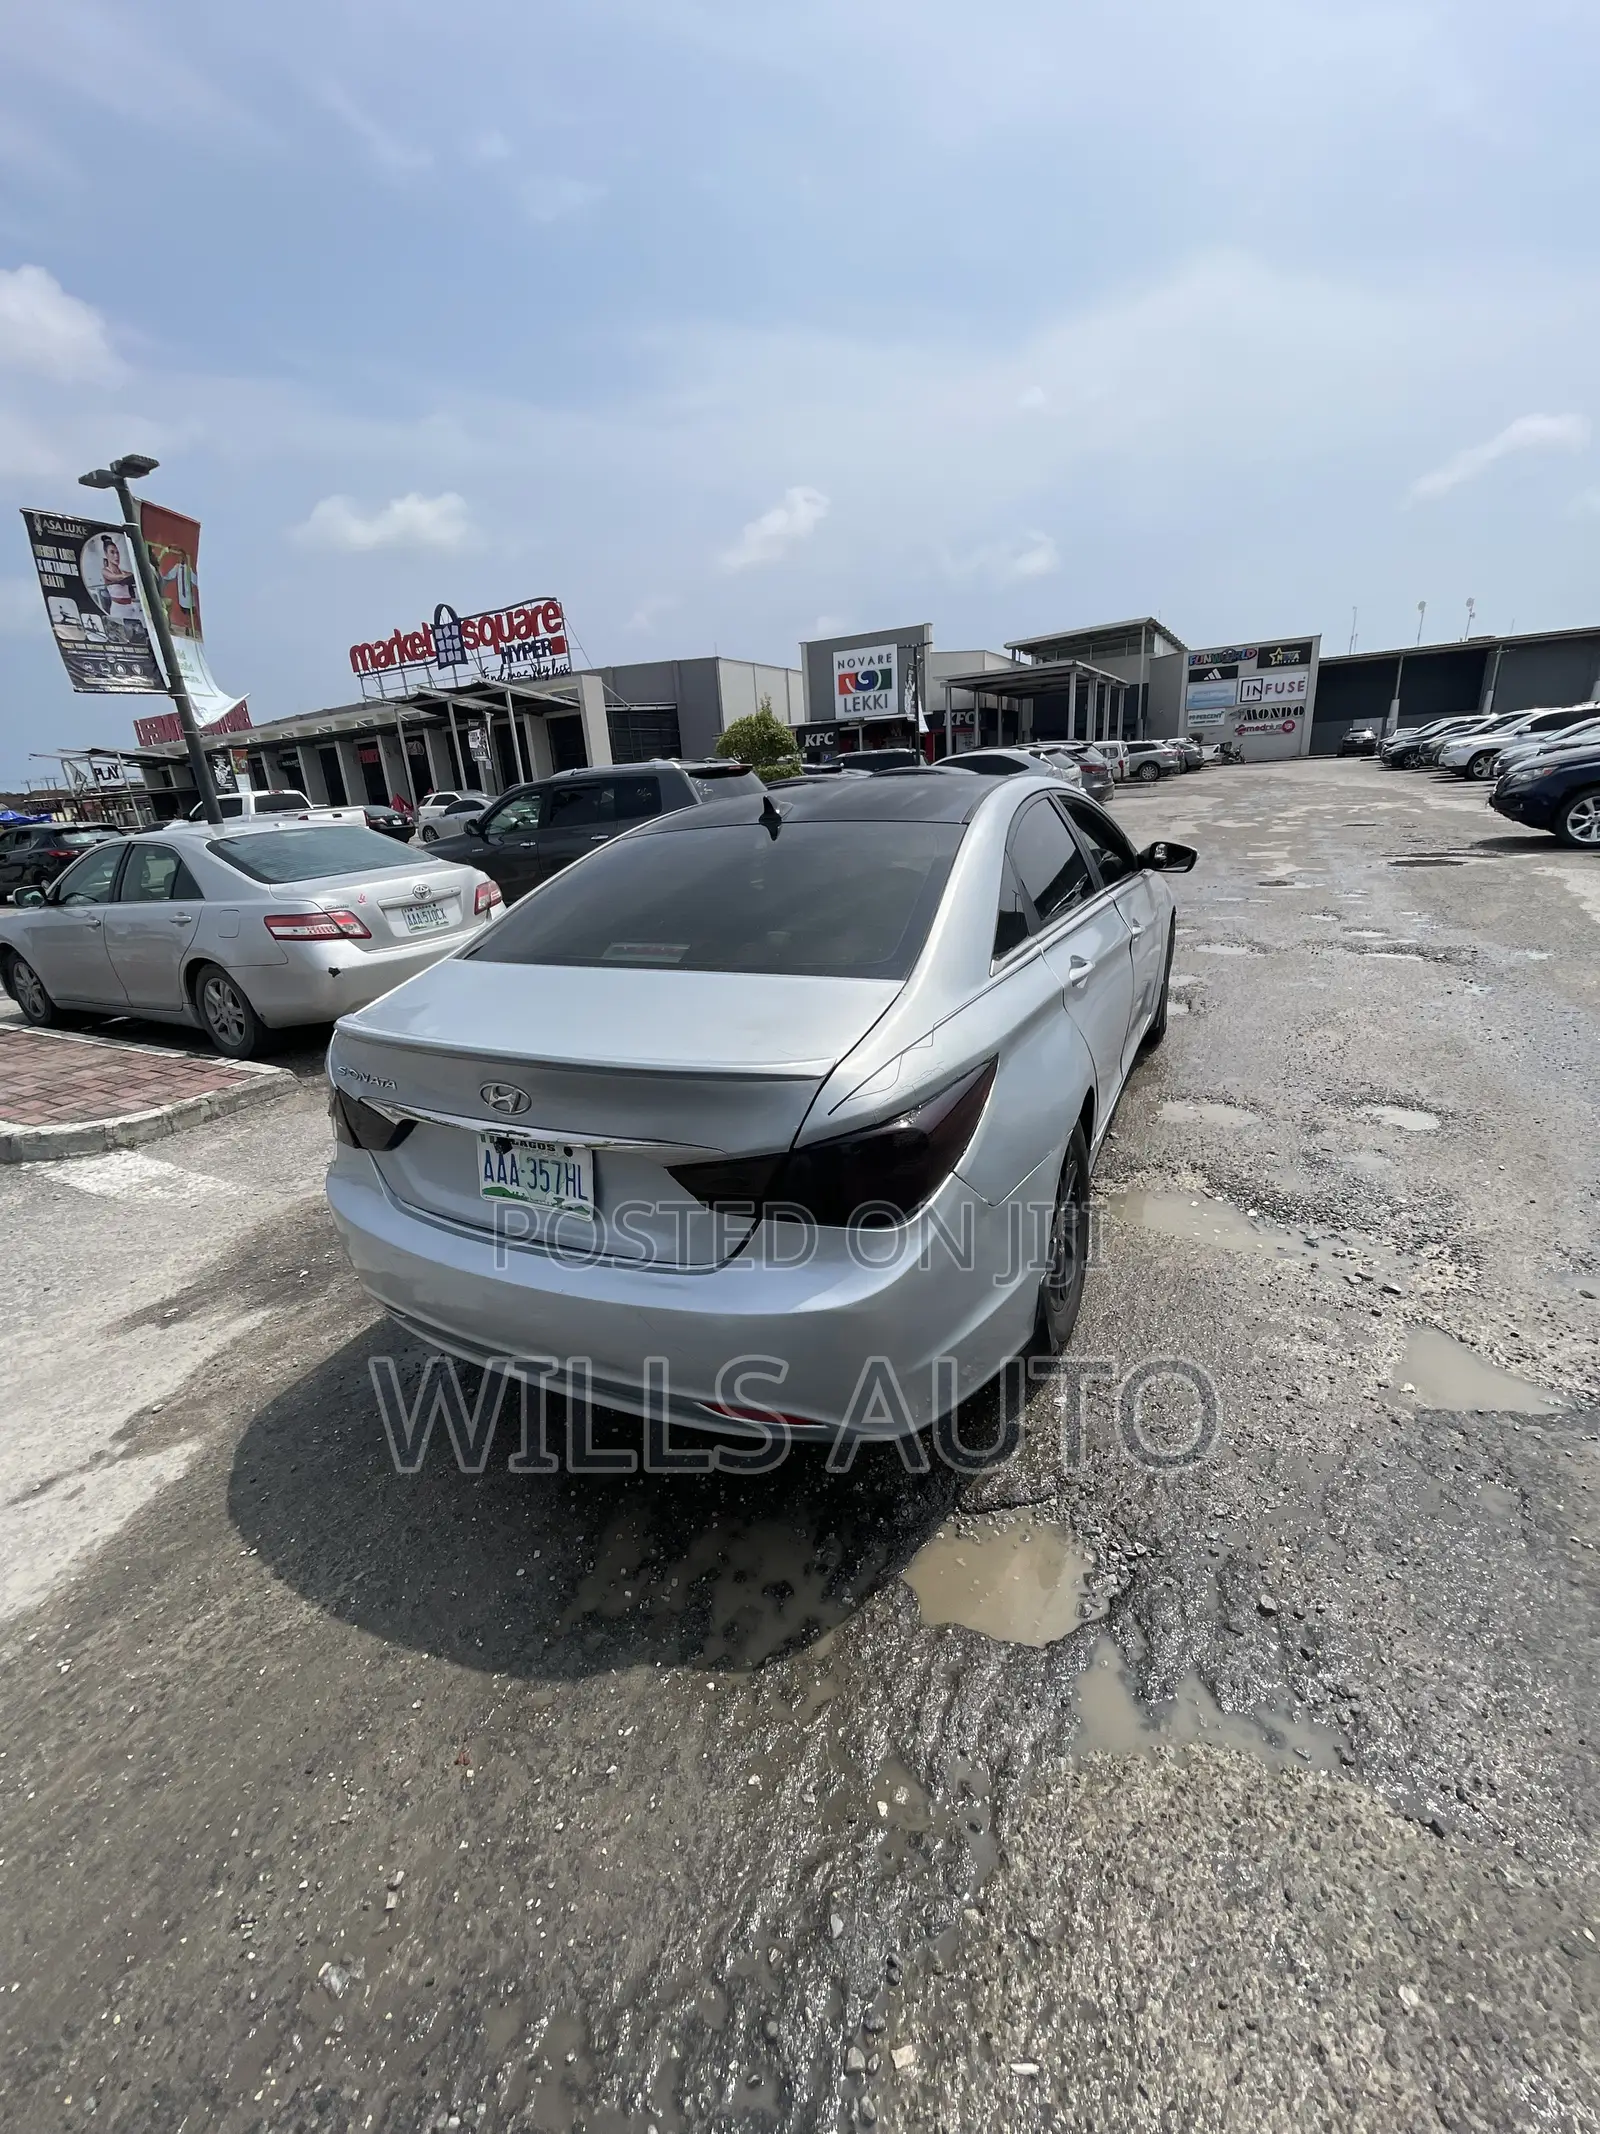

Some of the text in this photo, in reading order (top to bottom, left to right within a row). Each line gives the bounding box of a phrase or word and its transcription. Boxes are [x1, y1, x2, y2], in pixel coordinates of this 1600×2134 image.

[42, 519, 62, 531] ASA
[63, 522, 88, 536] LUXE
[349, 601, 563, 673] market square
[500, 638, 552, 665] HYPER
[837, 652, 893, 670] NOVARE
[1246, 680, 1306, 697] INFUSE
[843, 693, 889, 713] LEKKI
[1243, 705, 1306, 721] MONDO
[804, 731, 836, 748] KFC
[93, 764, 120, 781] PLAY
[337, 1065, 398, 1090] SONATA
